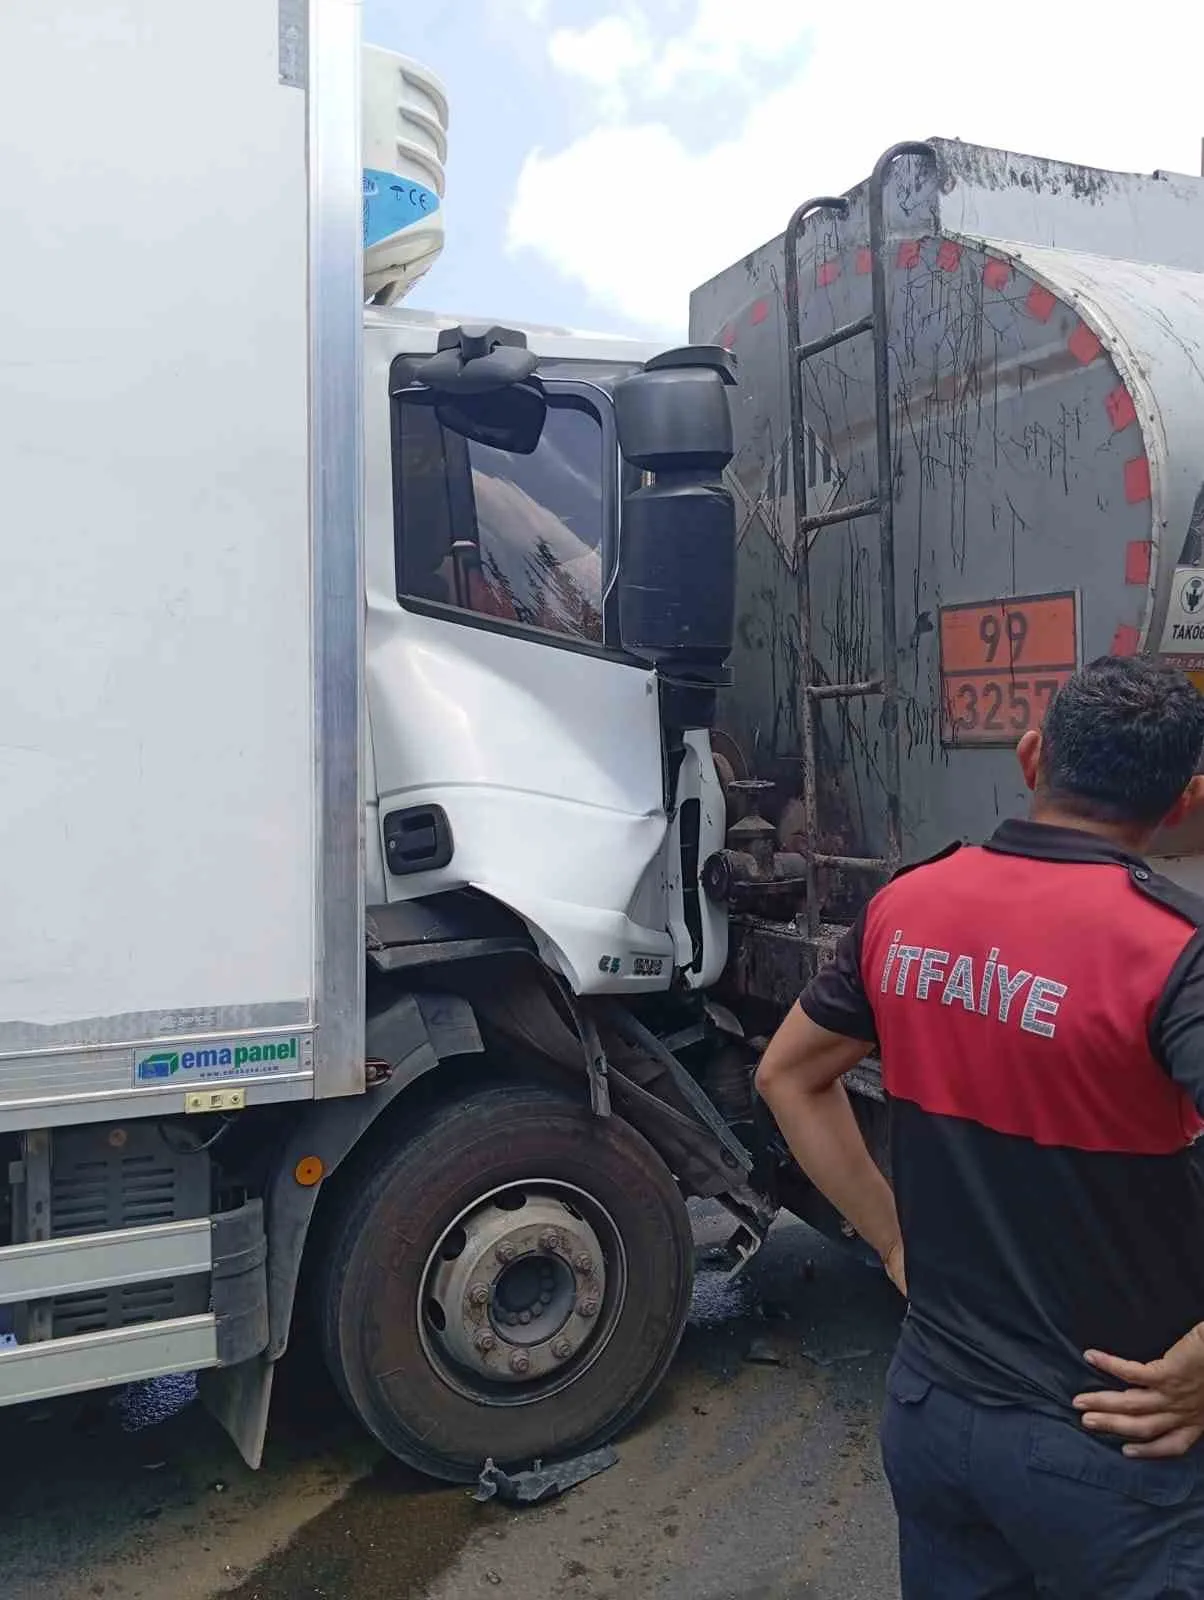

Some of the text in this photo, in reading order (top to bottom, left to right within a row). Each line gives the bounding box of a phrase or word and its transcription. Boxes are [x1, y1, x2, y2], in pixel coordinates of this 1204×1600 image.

[979, 611, 1028, 662] 99
[955, 680, 1058, 730] 3257
[881, 929, 1068, 1038] İTFAİYE
